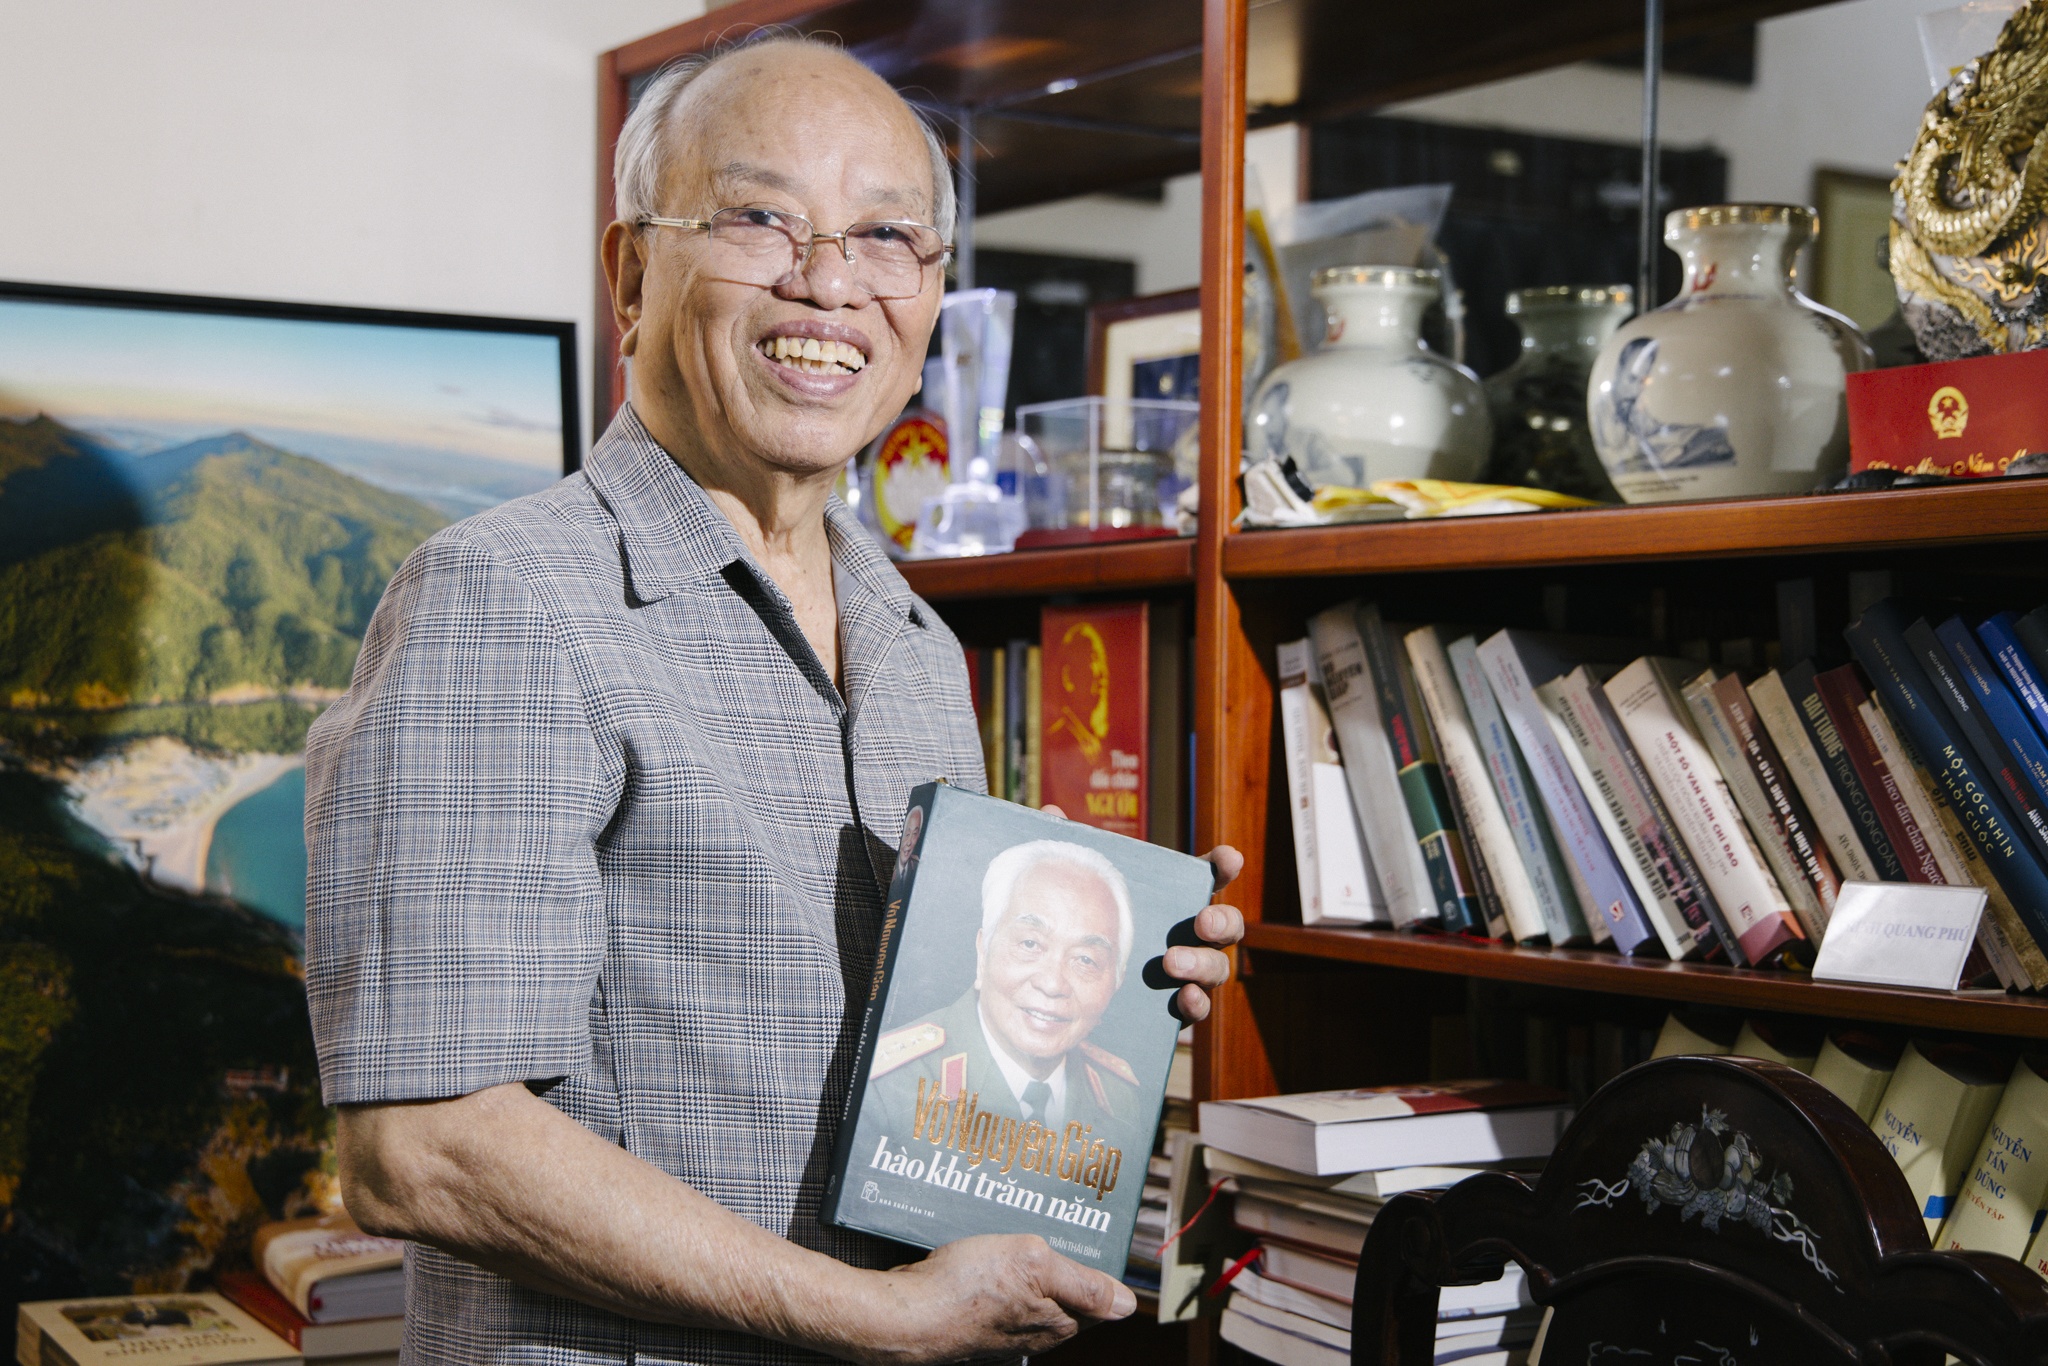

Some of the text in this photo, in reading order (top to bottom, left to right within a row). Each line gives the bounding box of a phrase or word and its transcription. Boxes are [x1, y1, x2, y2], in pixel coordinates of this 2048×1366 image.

[1942, 674, 1955, 689] VĂN
[1664, 729, 1683, 754] MỘT
[1677, 754, 1691, 770] SỐ
[1685, 771, 1703, 794] VĂN
[1757, 758, 1779, 784] TẠO
[1768, 782, 1791, 815] SÁNG
[1811, 713, 1847, 758] TƯỚNG
[1830, 754, 1866, 806] TRONG
[1854, 801, 1887, 845] LÒNG
[1875, 841, 1903, 876] DÂN
[1938, 767, 1997, 854] THỜI CUỘC
[1940, 742, 2018, 858] MỘT GÓC NHÌN
[1782, 813, 1800, 833] VÀ
[1879, 771, 1902, 802] Theo
[1894, 799, 1914, 824] dấu
[1904, 821, 1929, 853] chân
[1791, 829, 1812, 858] LĨNH
[1802, 854, 1825, 882] BẢN
[1884, 923, 1934, 939] QUANG
[1938, 924, 1970, 941] PHÚ
[913, 1077, 1122, 1202] Võ Nguyên Giáp
[1884, 1108, 1923, 1146] NGUYỄN
[1991, 1122, 2032, 1163] NGUYỄN
[1985, 1149, 2008, 1175] TẤN
[869, 1135, 1111, 1233] hào khí trăm năm
[1975, 1167, 2006, 1199] DŨNG
[879, 1198, 935, 1218] NHÀ XUẤT BẢN TRẺ
[1986, 1206, 2004, 1221] TẬP
[1068, 1241, 1083, 1254] THÁI
[1083, 1244, 1101, 1259] BÌNH
